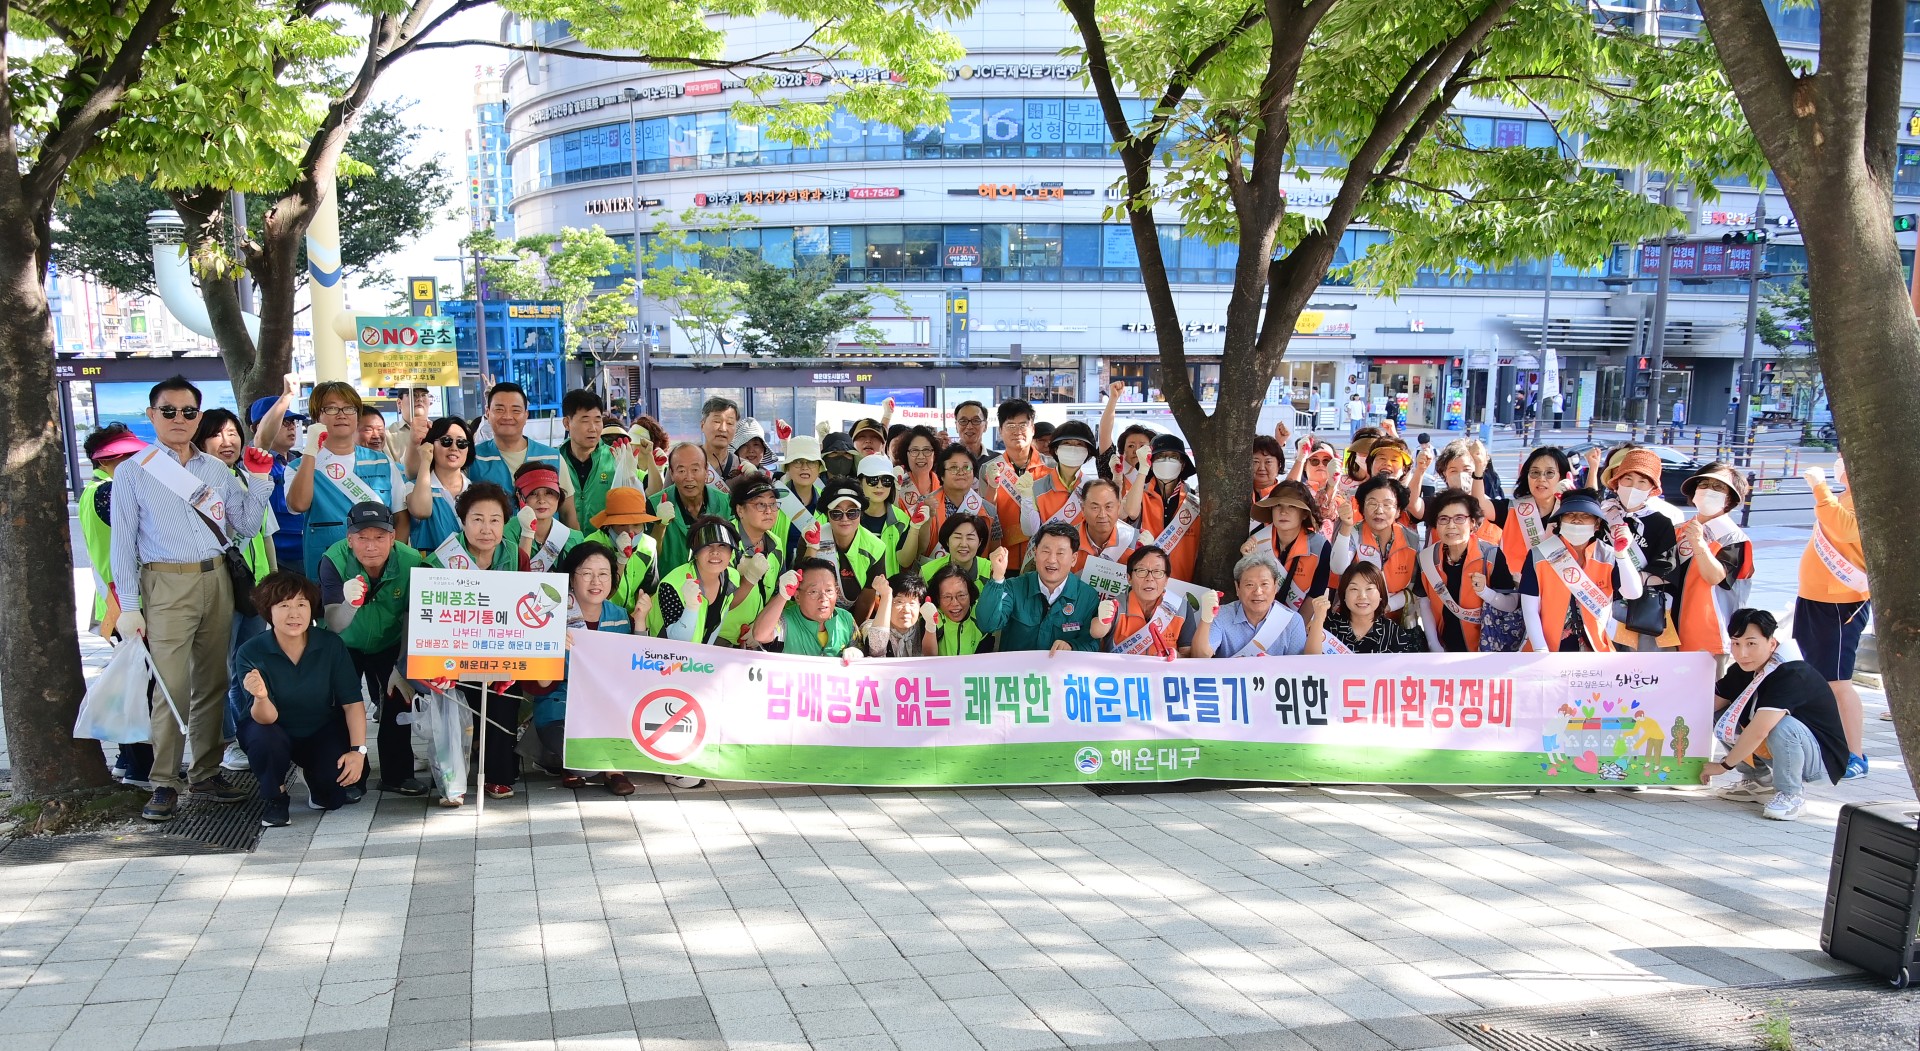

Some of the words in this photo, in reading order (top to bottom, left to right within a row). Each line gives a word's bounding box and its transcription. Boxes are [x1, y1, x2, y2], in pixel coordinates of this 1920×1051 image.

[642, 85, 677, 100] 이노의원
[1047, 102, 1101, 121] 피부과
[1028, 121, 1101, 140] 성형외과
[584, 132, 608, 148] 피부과
[743, 188, 822, 204] 정신건강의학과
[824, 187, 847, 201] 의원
[853, 189, 896, 197] 741-7542
[978, 183, 1016, 201] 헤어
[585, 195, 644, 215] LUMIERE
[949, 246, 976, 254] OPEN
[1673, 247, 1695, 258] 안경테
[1673, 260, 1694, 269] 최저가격
[1730, 260, 1750, 271] 최저가격
[424, 304, 433, 317] 4
[960, 318, 967, 331] 7
[994, 318, 1047, 332] OLENS
[1410, 318, 1424, 332] kt
[382, 327, 419, 346] NO
[420, 328, 453, 346] 꽁초
[82, 367, 101, 375] BRT
[856, 374, 873, 382] BRT
[902, 409, 929, 418] Busan
[930, 411, 938, 419] is
[421, 590, 490, 607] 담배꽁초는
[420, 609, 433, 623] 꼭
[439, 609, 508, 625] 쓰레기통에
[452, 628, 482, 638] 나부터!
[487, 629, 525, 638] 지금부터!
[415, 638, 449, 649] 담배꽁초
[453, 639, 469, 649] 없는
[472, 640, 505, 650] 아름다운
[508, 641, 532, 650] 해운대
[535, 641, 559, 650] 만들기
[644, 650, 689, 661] Sun&Fun
[459, 661, 499, 670] 해운대구
[502, 661, 528, 670] 우1동
[632, 653, 715, 676] Haeundae
[1615, 673, 1659, 689] 해운대
[894, 676, 951, 727] 없는
[964, 673, 1051, 725] 쾌적한
[1063, 673, 1152, 723] 해운대
[1274, 675, 1329, 726] 위한
[1342, 676, 1513, 728] 도시환경정비
[1111, 747, 1200, 771] 해운대구
